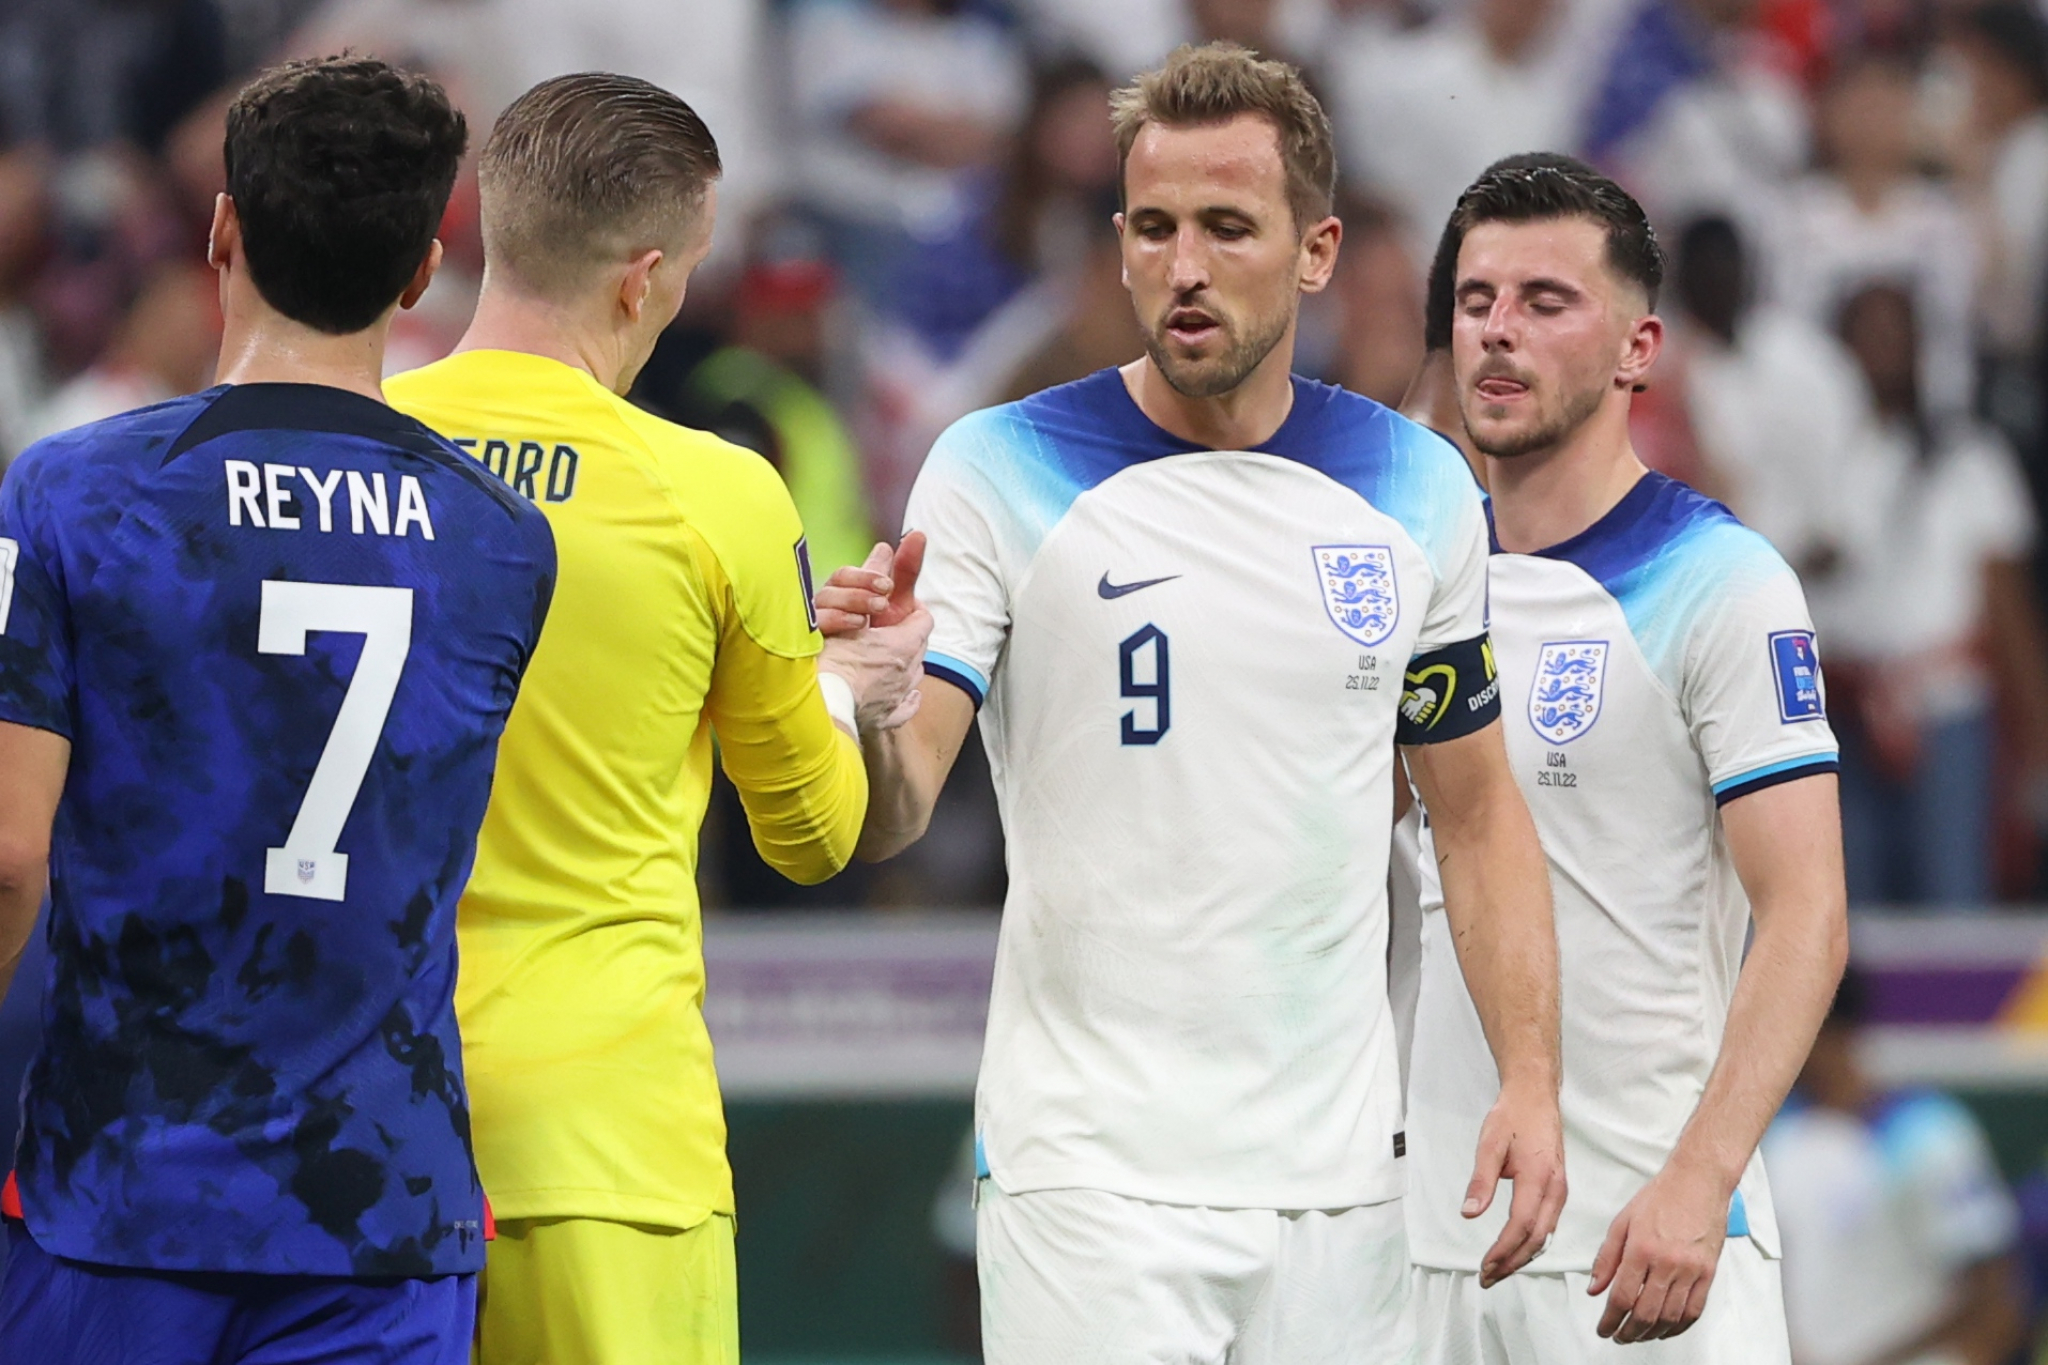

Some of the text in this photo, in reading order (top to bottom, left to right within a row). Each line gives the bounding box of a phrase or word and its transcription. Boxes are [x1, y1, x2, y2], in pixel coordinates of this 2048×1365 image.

[453, 438, 579, 503] ORD
[225, 459, 435, 541] REYNA
[1345, 674, 1380, 691] 25.11.22
[1359, 654, 1377, 671] USA
[1119, 621, 1171, 746] 9
[258, 579, 413, 901] 7
[1547, 751, 1567, 768] USA
[1537, 770, 1578, 788] 25.11.22
